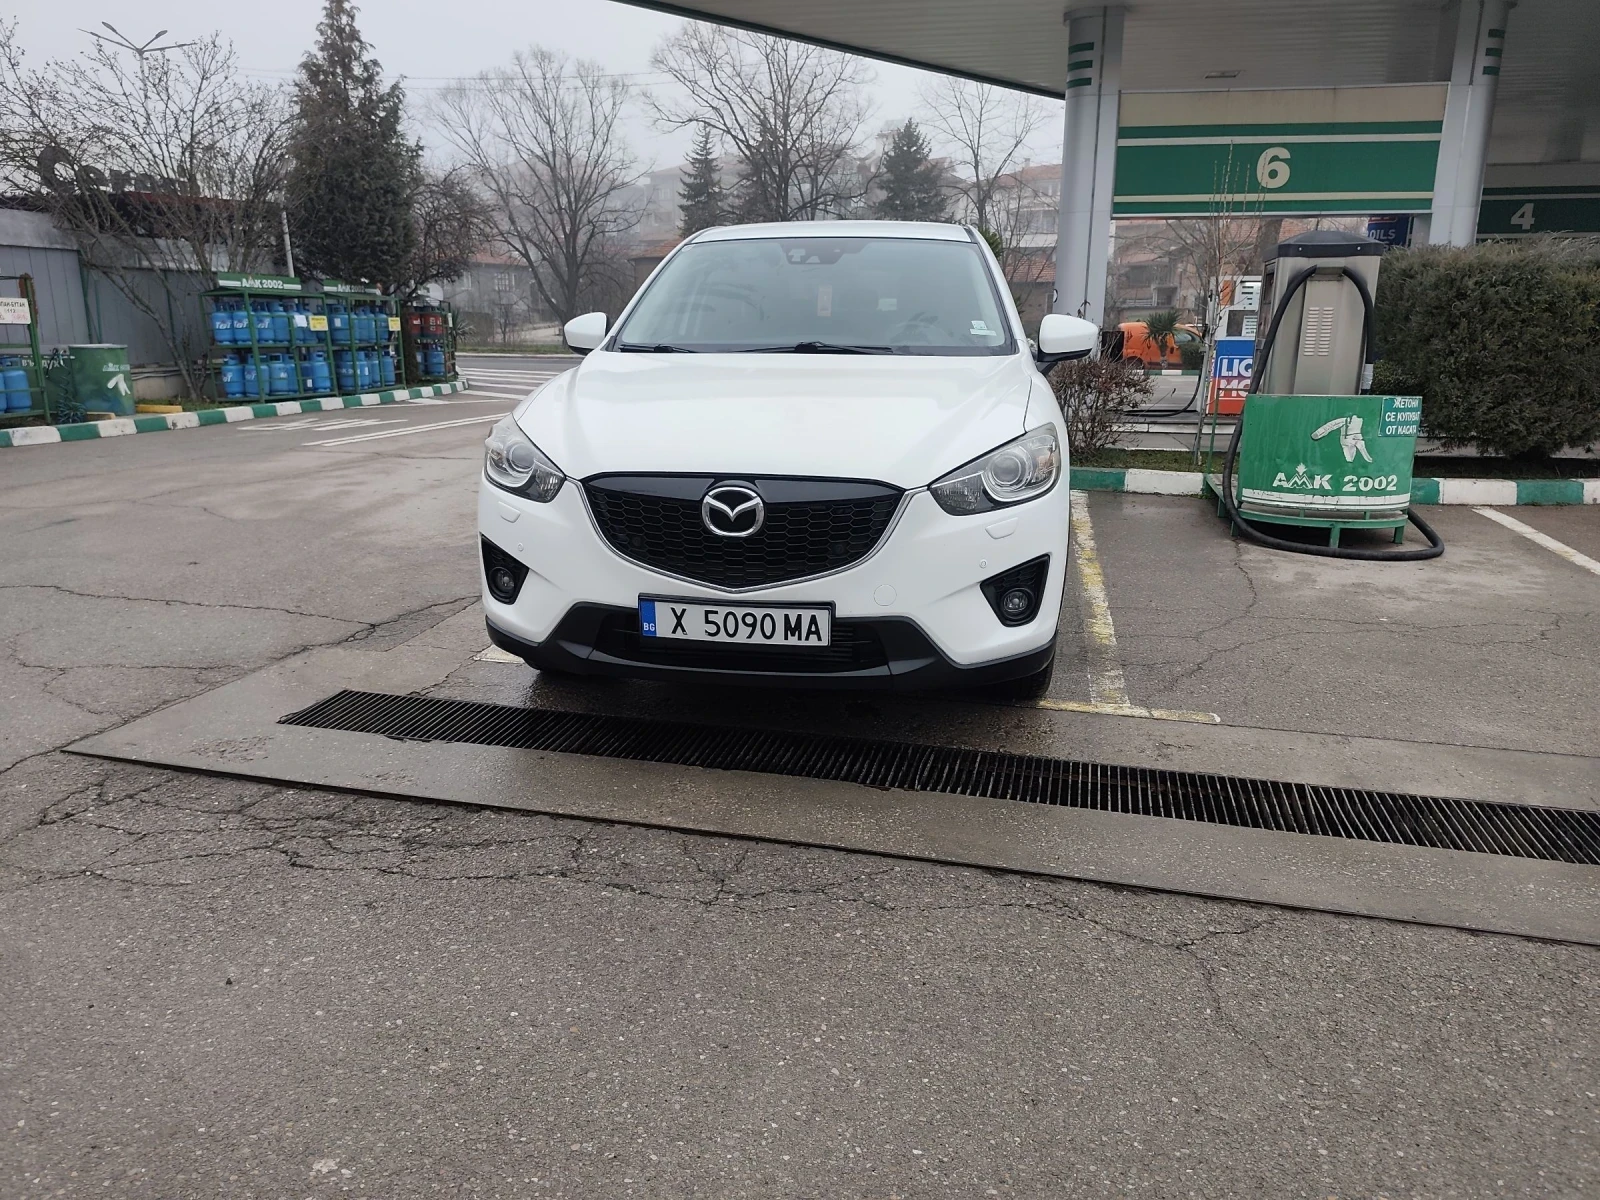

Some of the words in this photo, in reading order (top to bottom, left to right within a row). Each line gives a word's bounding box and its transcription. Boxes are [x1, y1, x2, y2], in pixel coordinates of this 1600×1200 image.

[1257, 147, 1291, 188] 6
[1511, 203, 1535, 230] 4
[262, 280, 284, 289] 2002
[22, 360, 60, 370] ВЪДУХ
[1385, 411, 1397, 422] СЕ
[1385, 425, 1397, 435] ОТ
[1342, 474, 1398, 491] 2002
[643, 622, 655, 631] BG
[670, 607, 688, 635] X
[704, 609, 776, 640] 5090
[783, 613, 822, 642] MA
